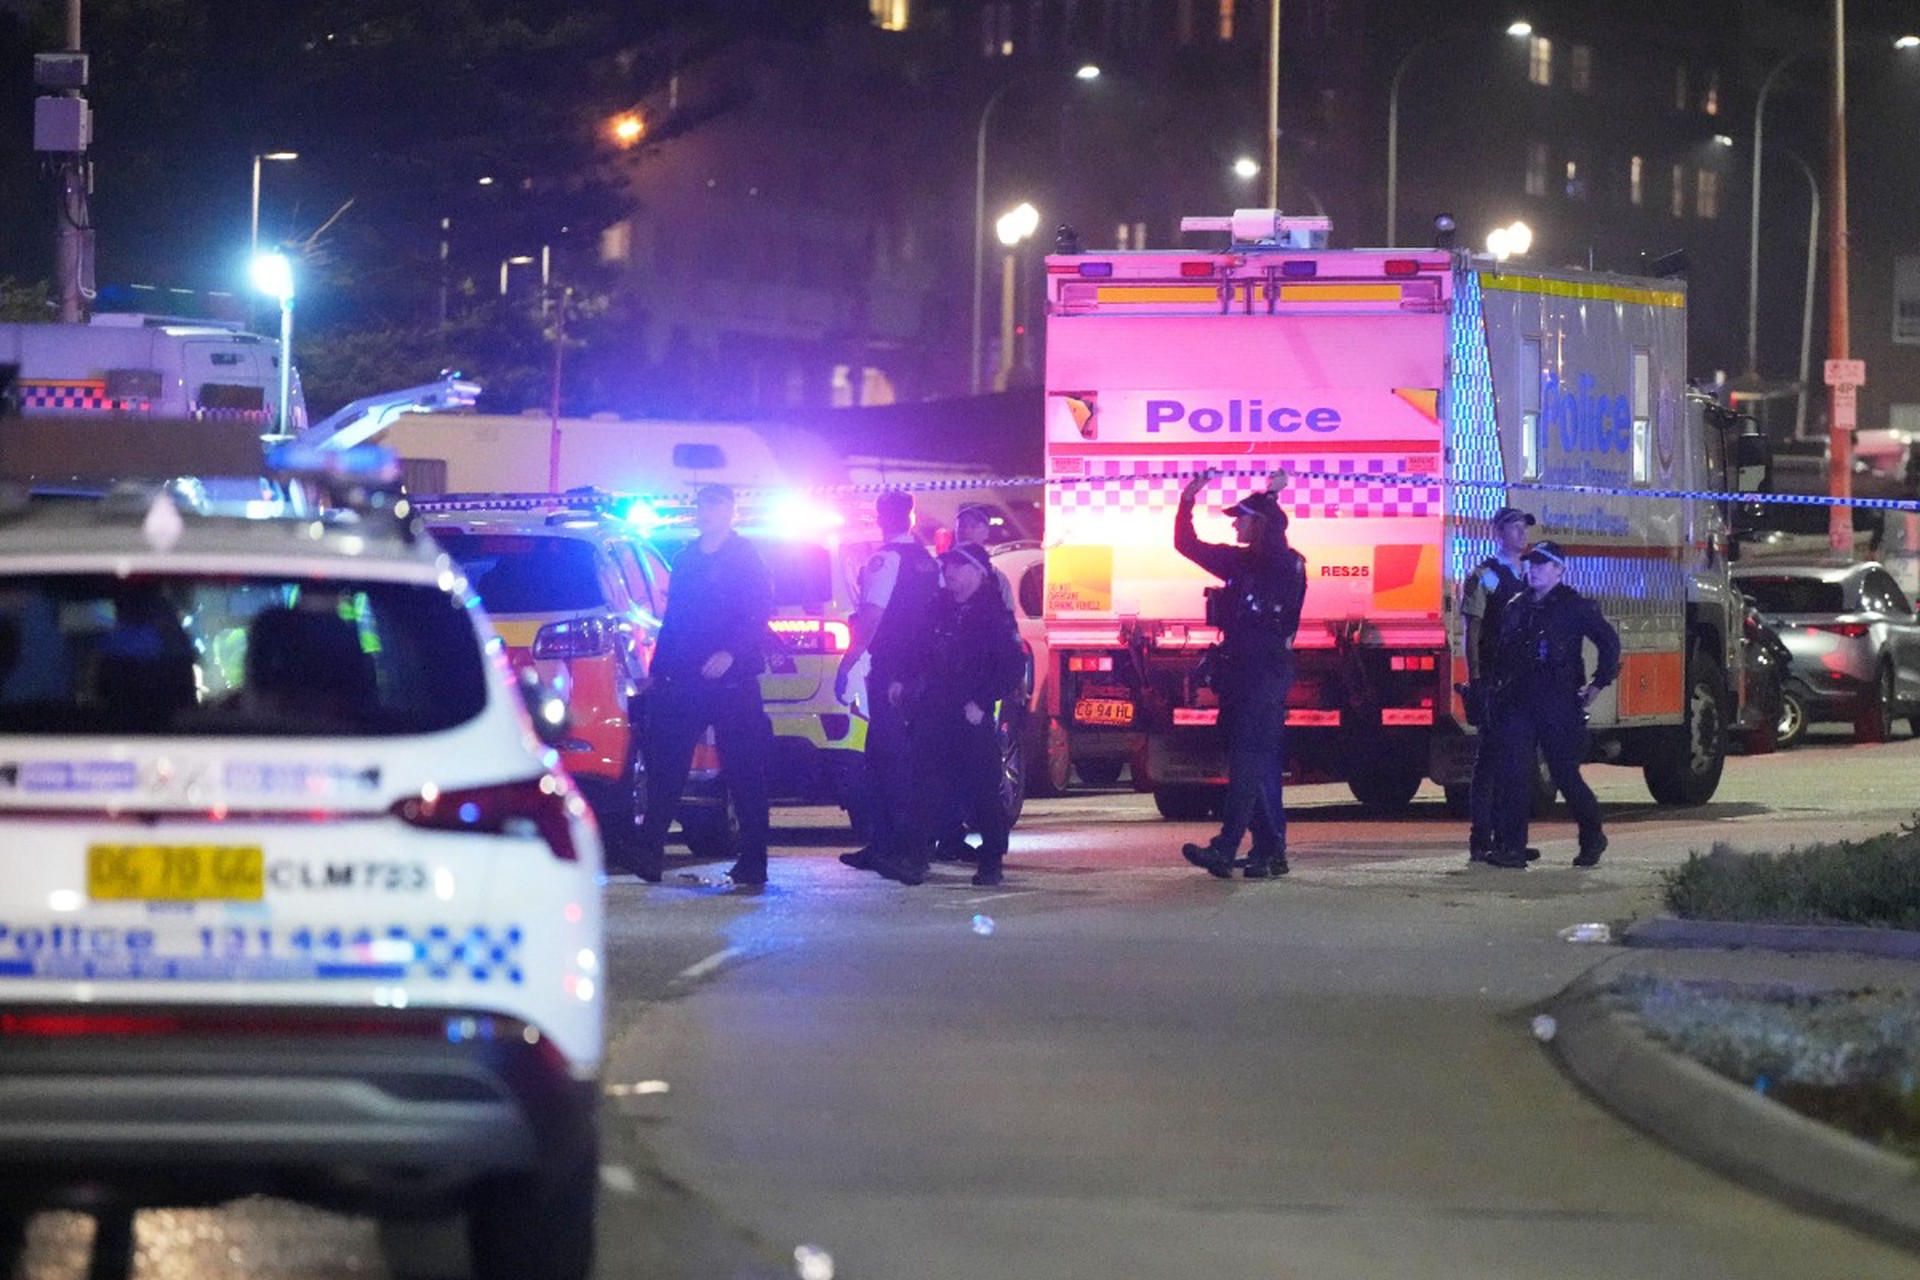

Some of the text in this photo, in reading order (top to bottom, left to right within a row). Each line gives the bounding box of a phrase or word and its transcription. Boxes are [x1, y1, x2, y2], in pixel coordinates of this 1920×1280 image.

[1146, 399, 1342, 434] Police
[1540, 371, 1631, 455] Police
[1321, 566, 1369, 577] RES25
[1097, 704, 1112, 717] 94
[1116, 704, 1131, 719] HL
